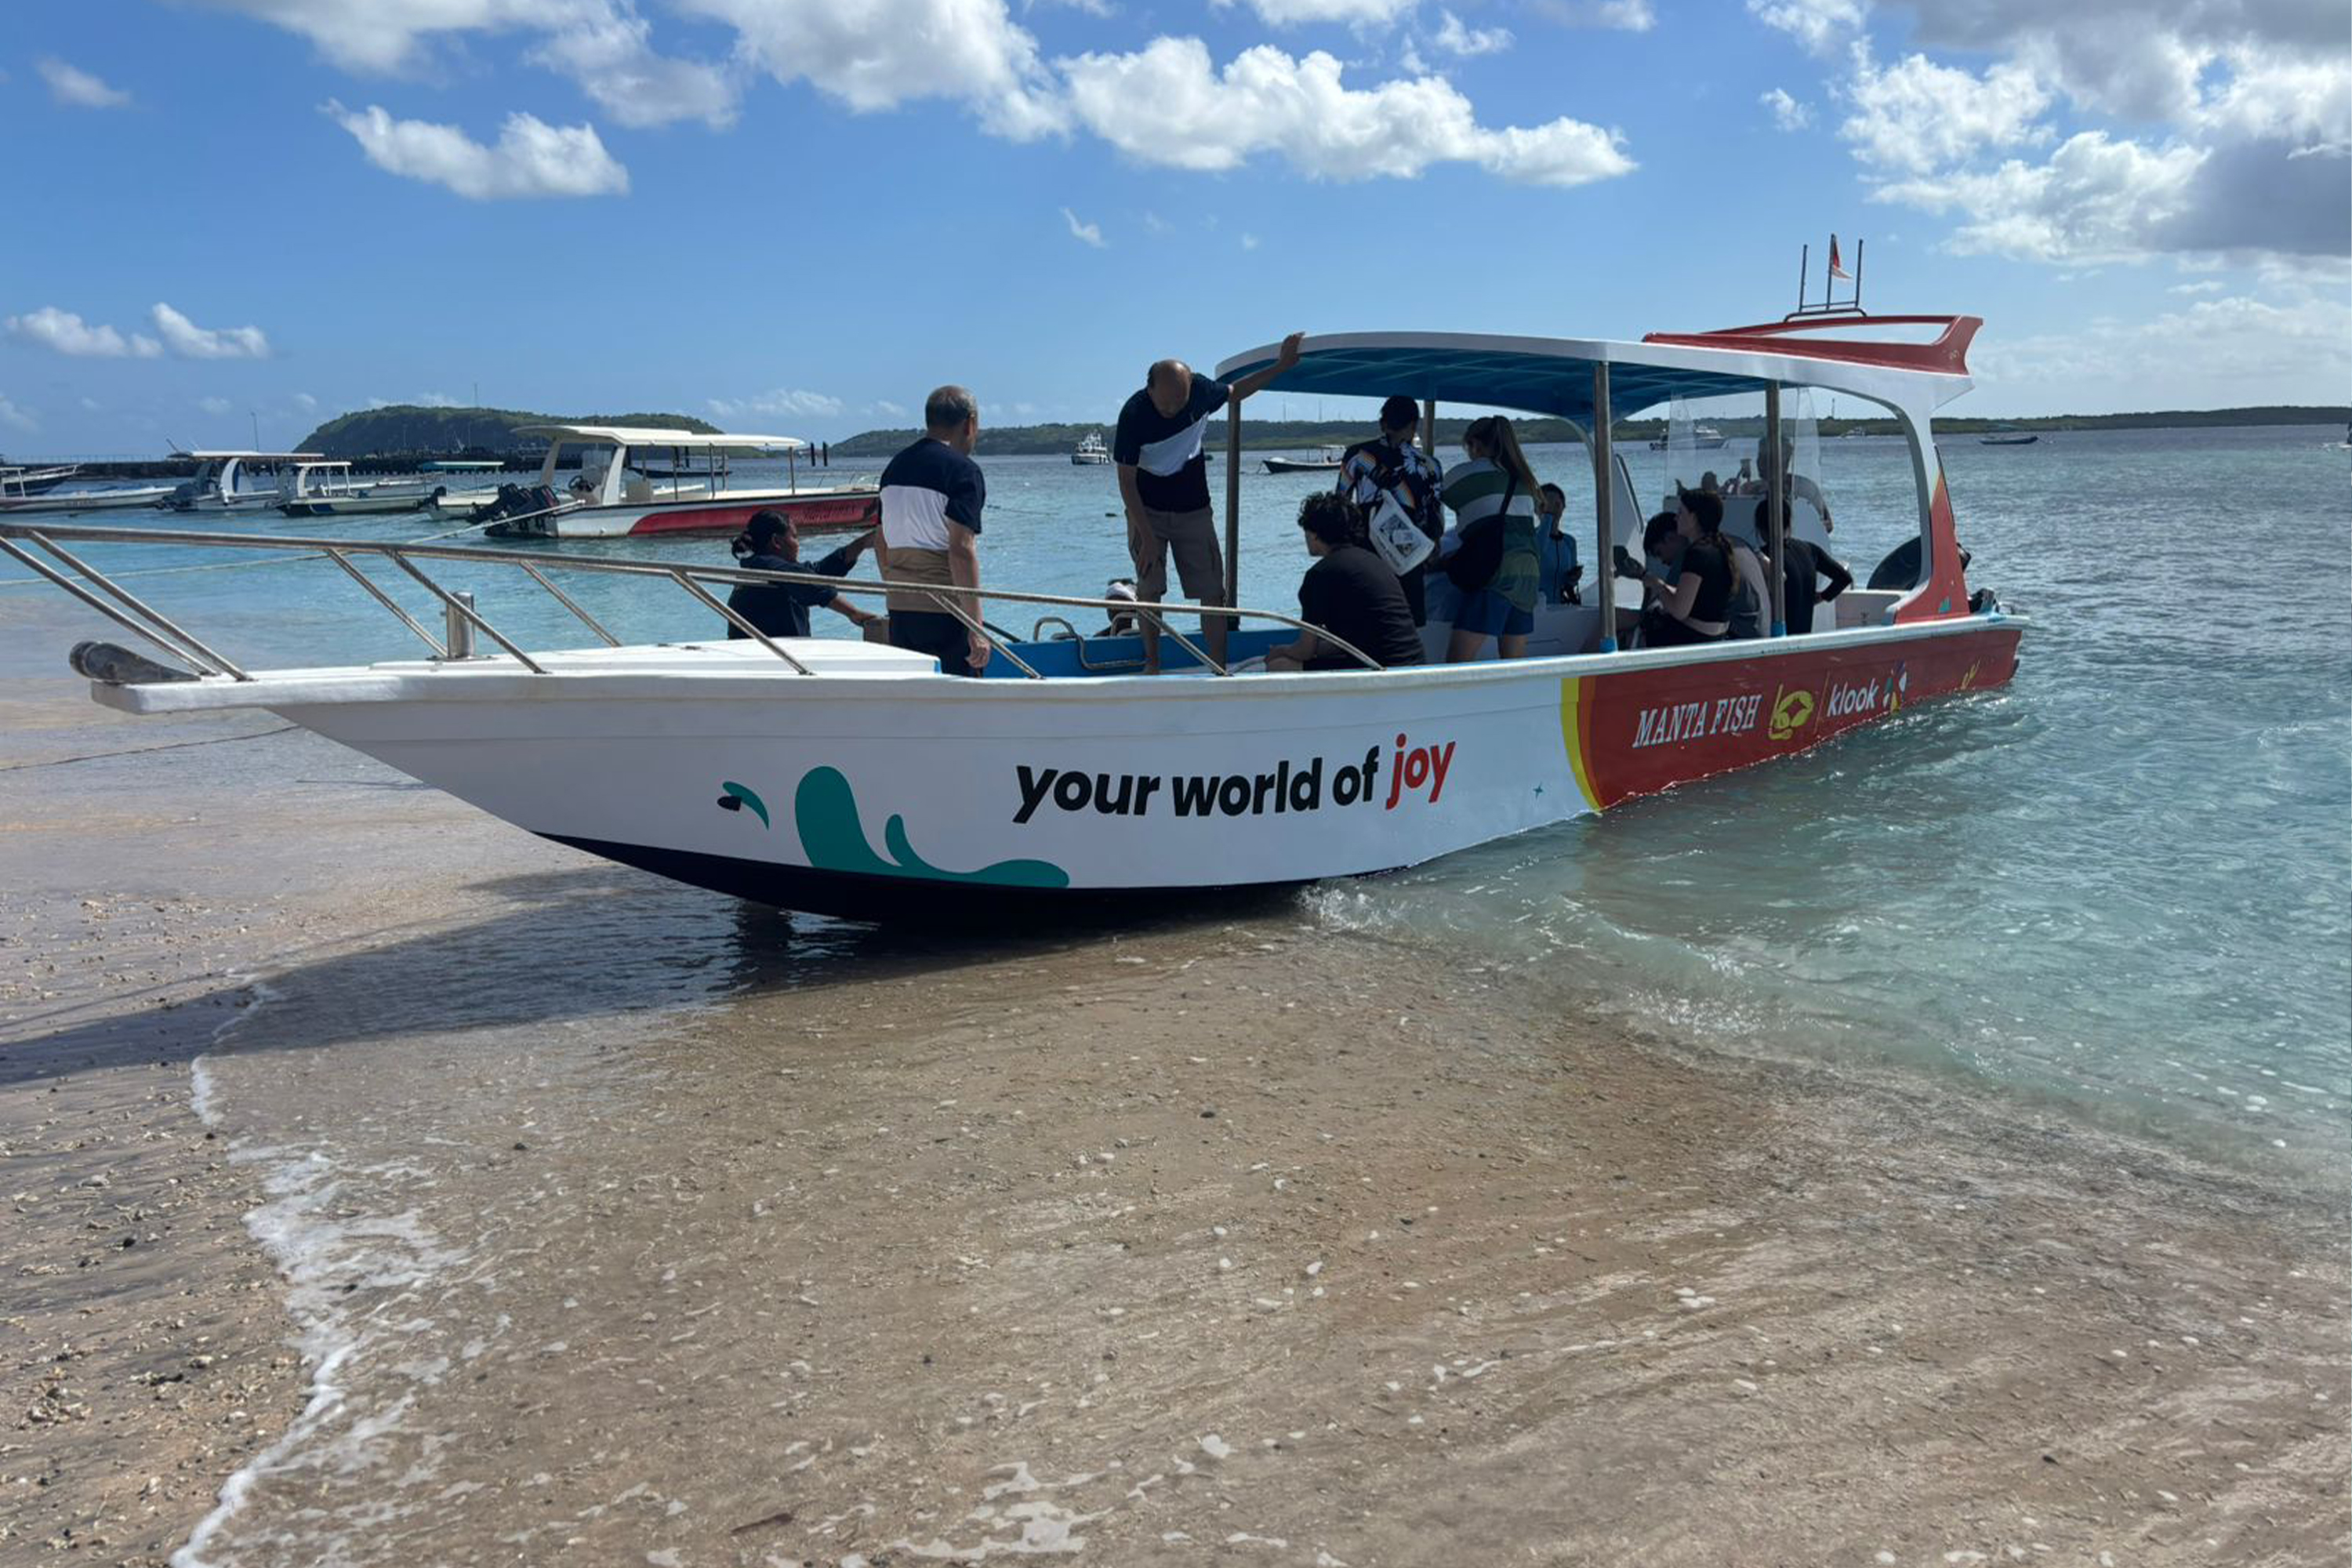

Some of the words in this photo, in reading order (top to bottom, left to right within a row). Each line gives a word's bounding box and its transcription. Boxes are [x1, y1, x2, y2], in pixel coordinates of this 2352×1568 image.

[1632, 701, 1708, 748] MANTA
[1709, 695, 1762, 735] FISH
[1827, 677, 1879, 717] klook
[1012, 765, 1160, 824] your
[1172, 757, 1323, 817] world
[1333, 745, 1380, 807] of
[1385, 733, 1457, 811] joy
